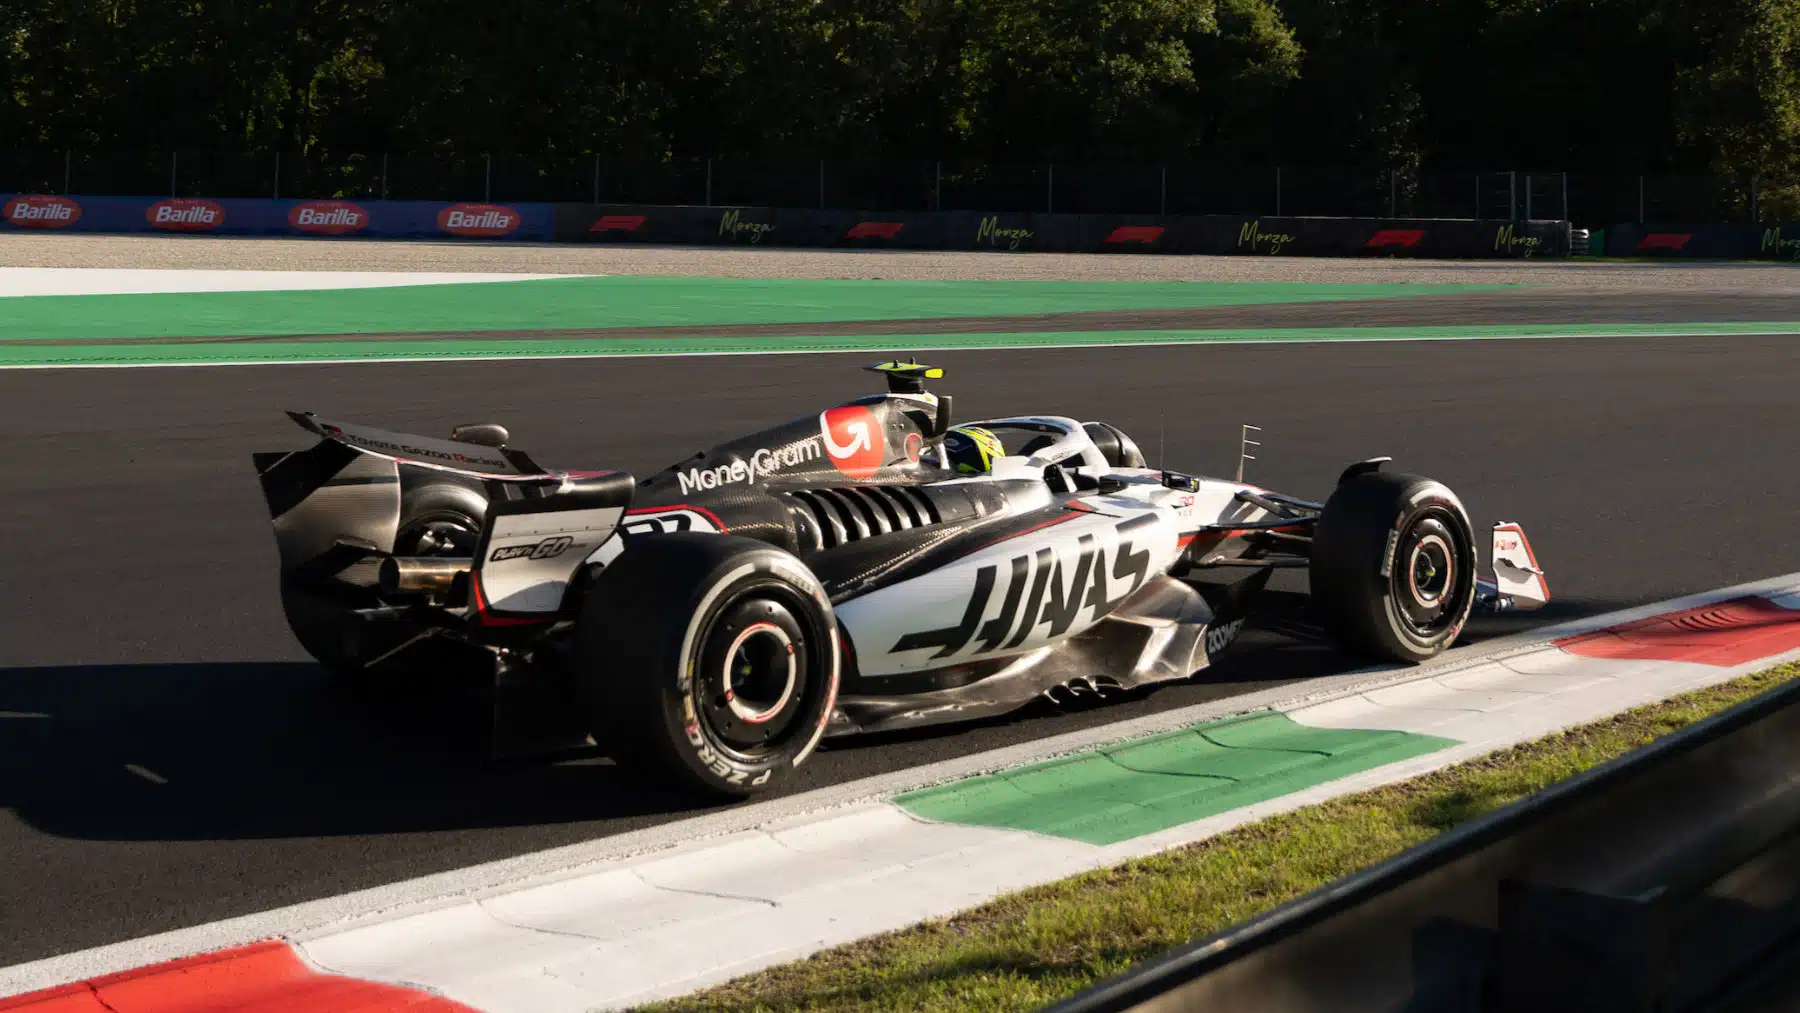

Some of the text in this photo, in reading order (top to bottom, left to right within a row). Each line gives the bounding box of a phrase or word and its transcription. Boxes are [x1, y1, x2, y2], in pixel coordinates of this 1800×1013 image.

[12, 203, 72, 220] Barilla
[155, 206, 215, 223] Barilla
[297, 208, 358, 226] Barilla
[446, 211, 509, 228] Barilla
[718, 207, 776, 244] Monza
[976, 215, 1033, 250] Monza
[1237, 220, 1295, 255] Monza
[1494, 224, 1543, 257] Monza
[452, 453, 506, 469] Racing
[676, 434, 822, 495] MoneyGram
[888, 512, 1160, 660] HAAS
